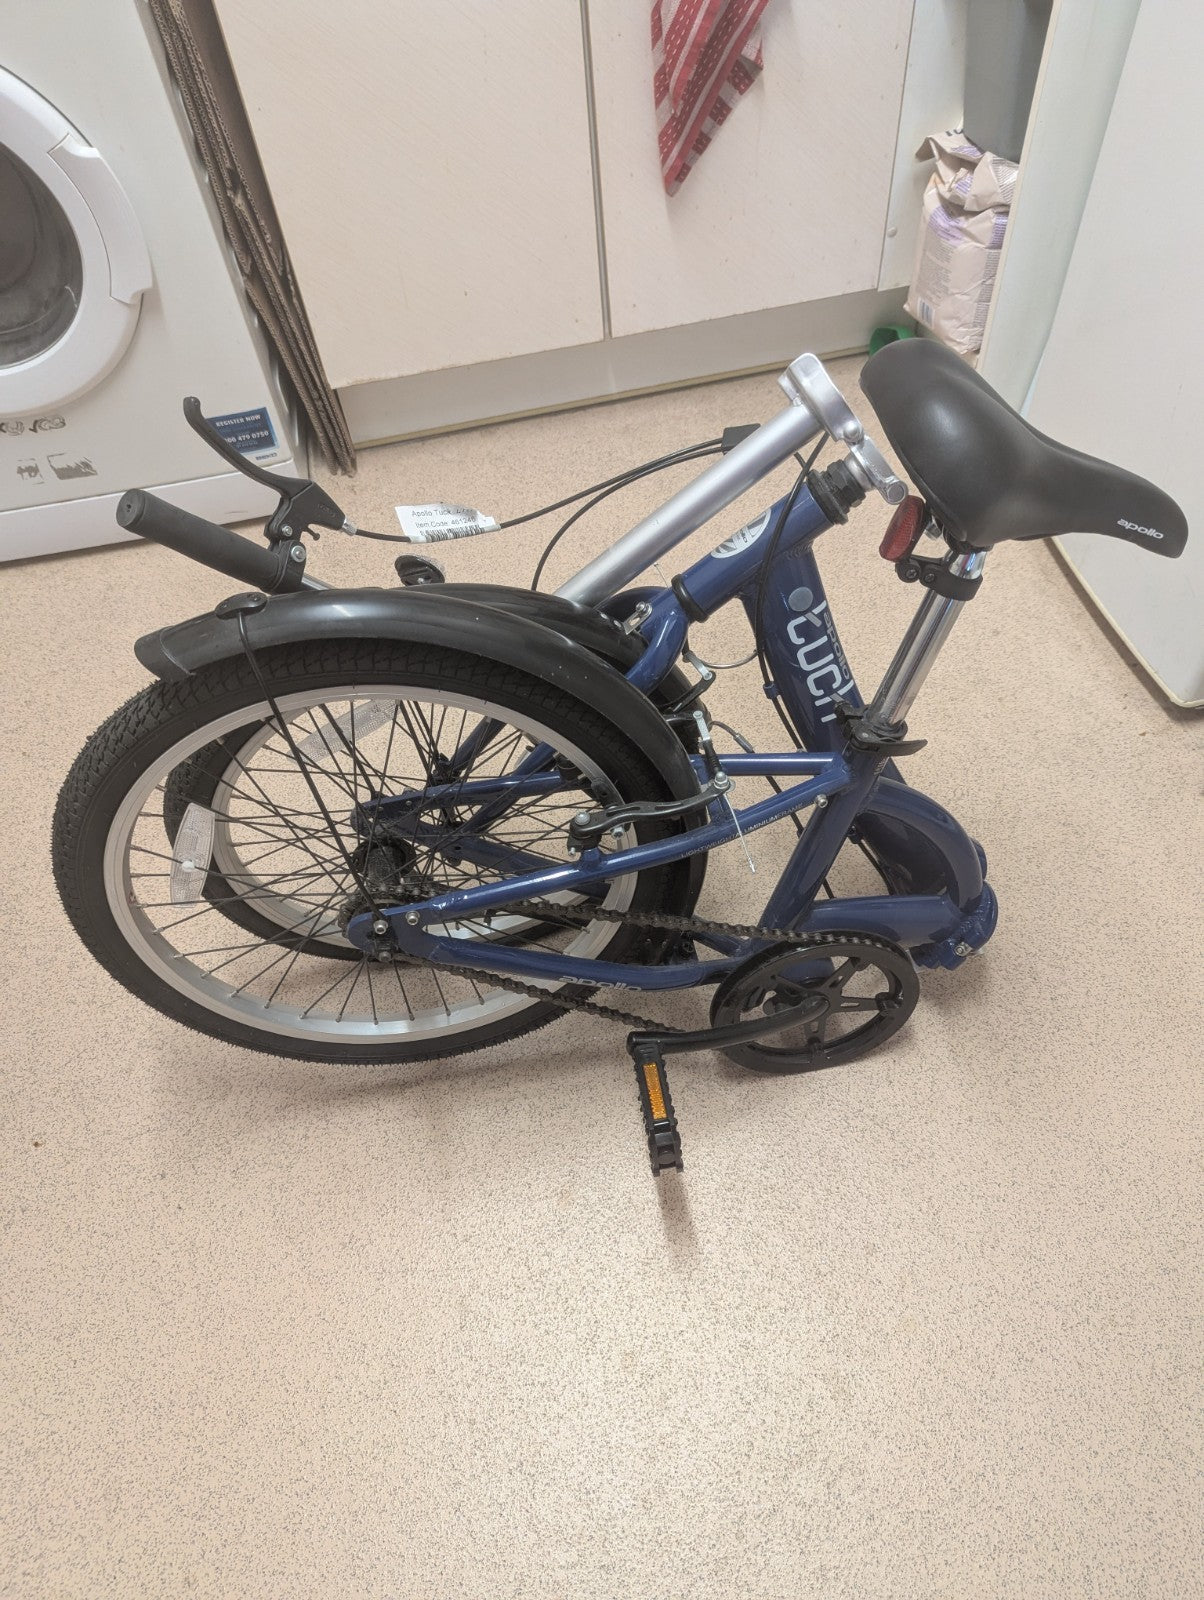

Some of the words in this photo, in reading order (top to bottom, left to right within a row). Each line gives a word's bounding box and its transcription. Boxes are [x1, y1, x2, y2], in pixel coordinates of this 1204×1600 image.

[216, 417, 245, 427] REGISTER
[246, 414, 261, 422] NOW
[1117, 518, 1164, 539] apollo
[558, 975, 642, 992] apollo
